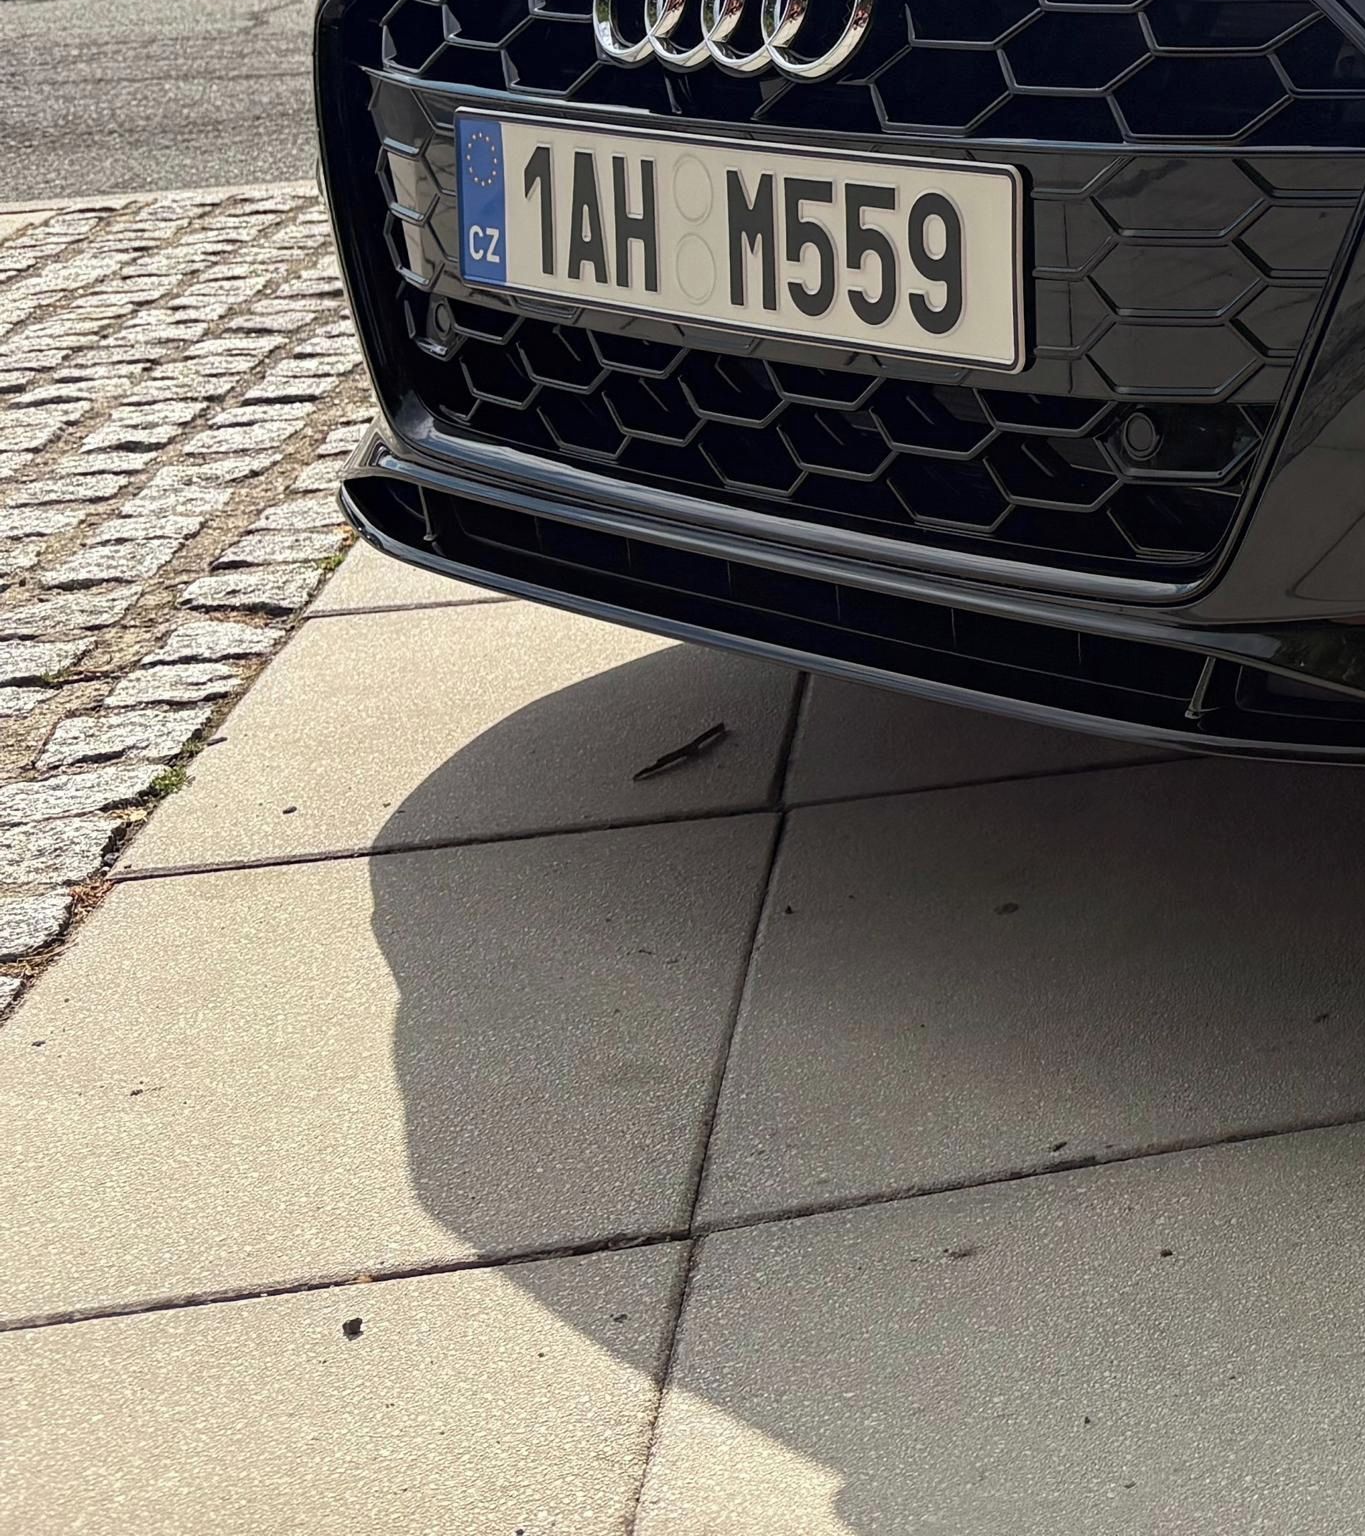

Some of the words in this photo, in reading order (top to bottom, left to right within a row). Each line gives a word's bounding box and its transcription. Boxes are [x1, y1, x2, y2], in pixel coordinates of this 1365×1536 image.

[468, 225, 500, 263] CZ
[523, 145, 658, 293] 1AH
[726, 167, 964, 336] M559
